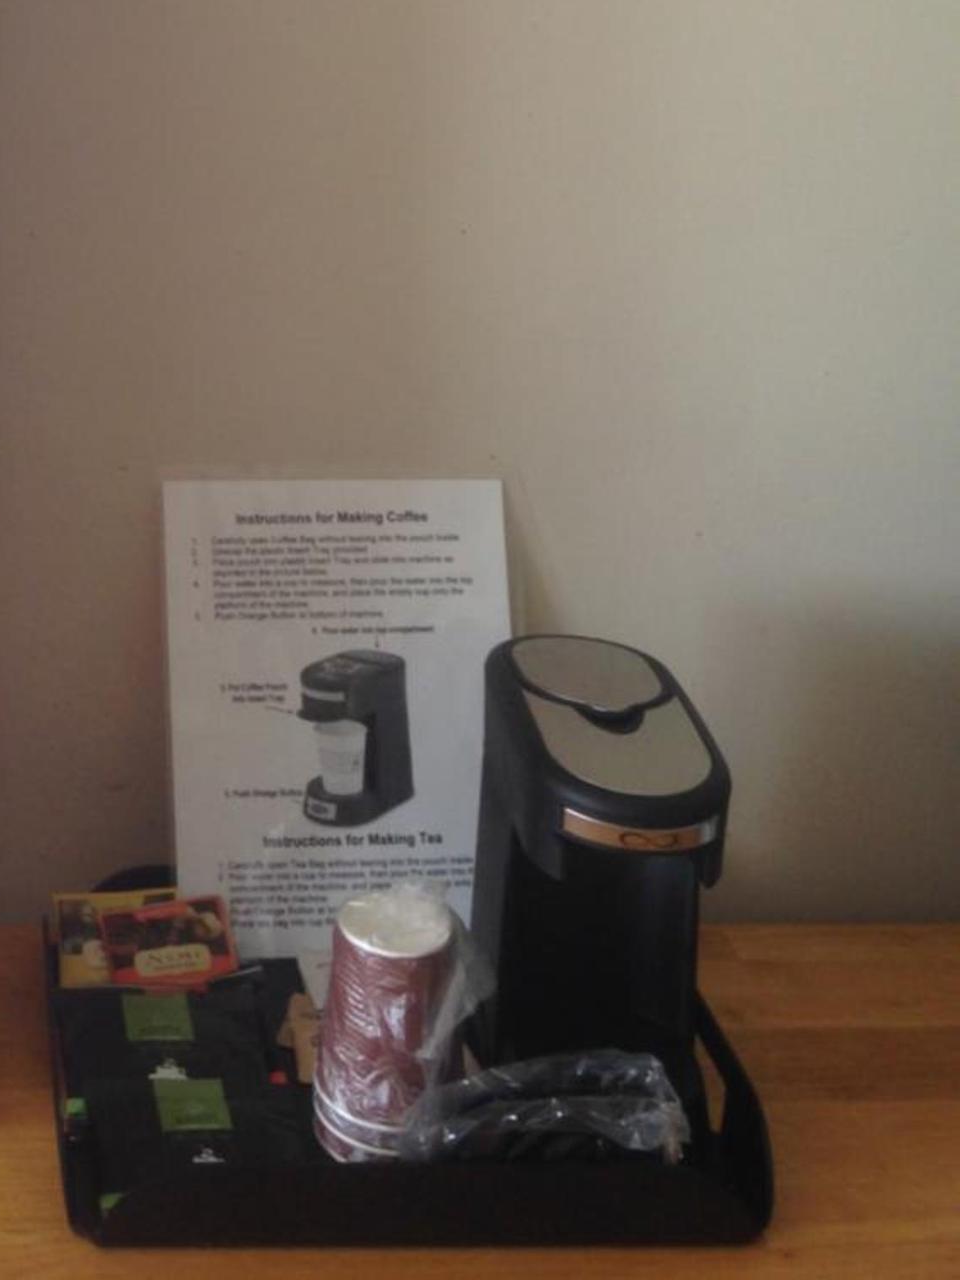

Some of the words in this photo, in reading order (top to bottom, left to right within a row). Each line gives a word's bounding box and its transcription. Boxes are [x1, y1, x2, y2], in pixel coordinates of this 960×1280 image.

[235, 513, 312, 525] Instructions
[315, 511, 334, 524] for
[336, 511, 383, 526] Making
[386, 510, 428, 523] Coffee
[262, 835, 342, 848] Instructions
[345, 833, 364, 847] for
[367, 831, 416, 848] Making
[419, 830, 443, 845] Tea
